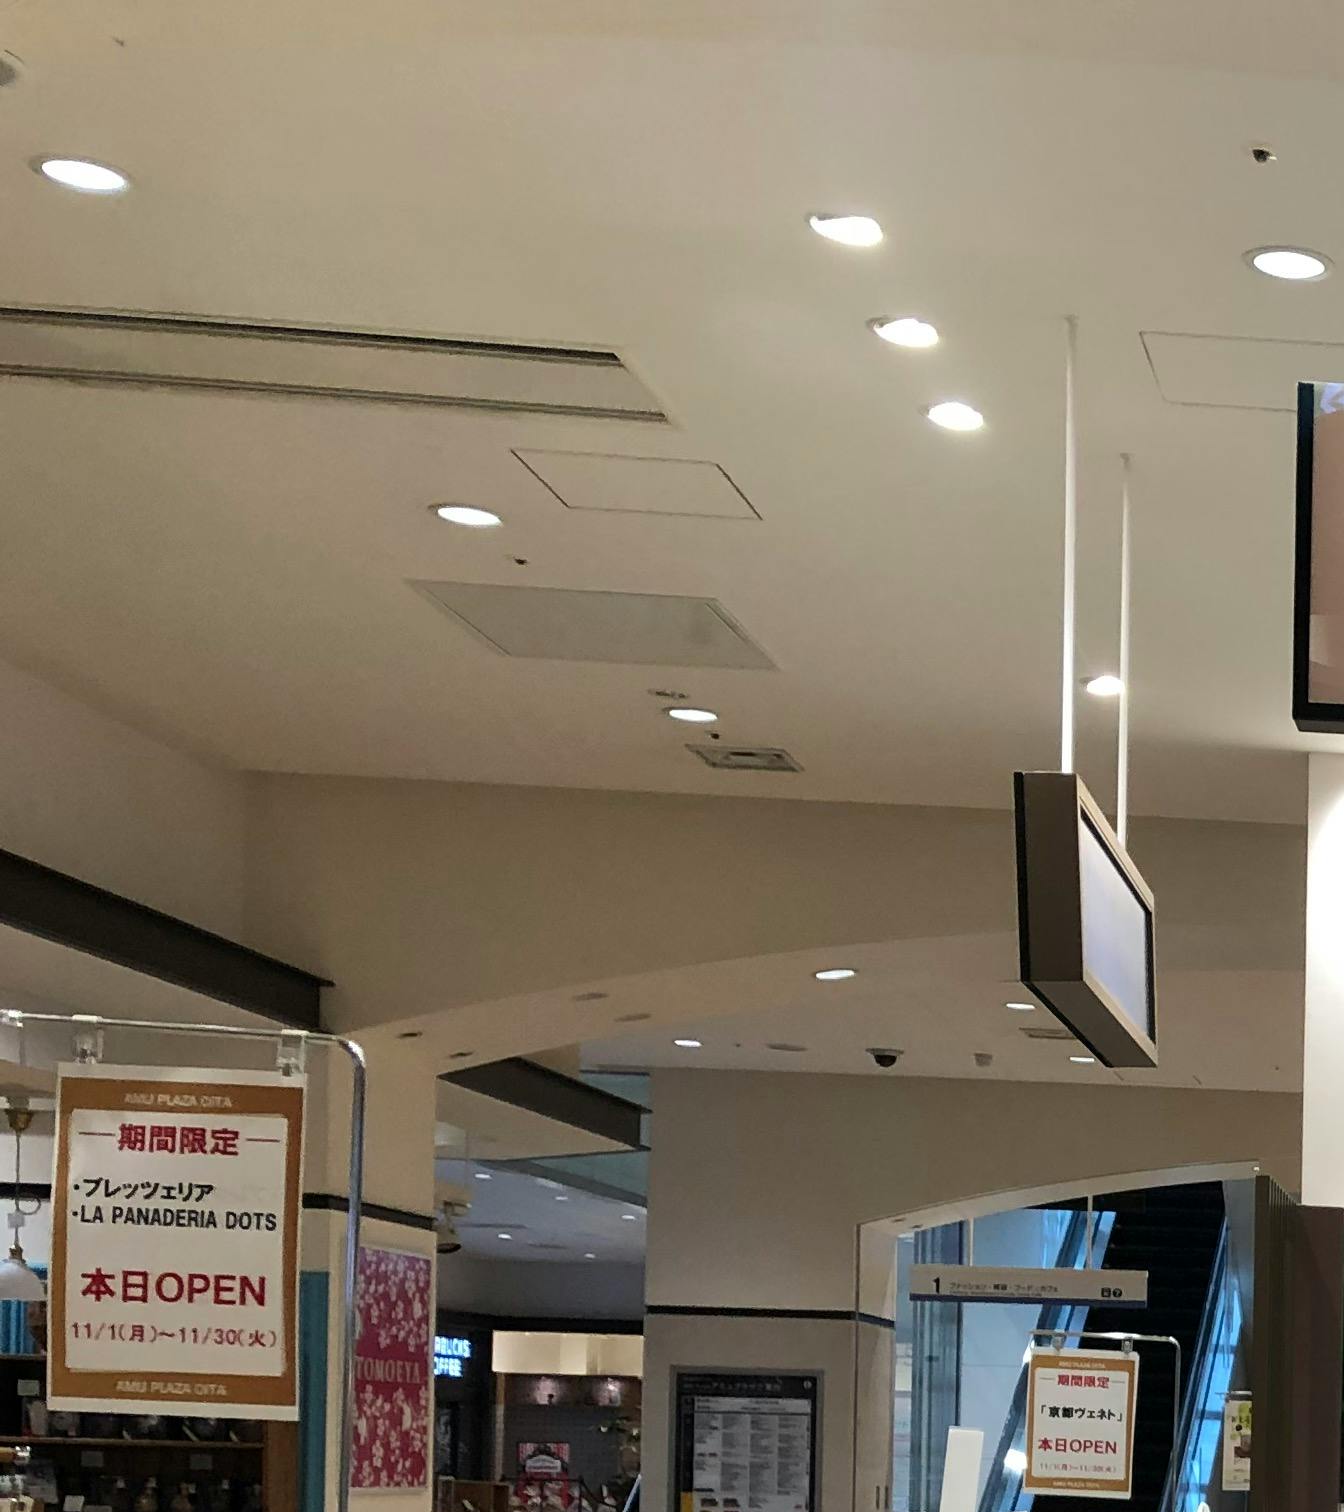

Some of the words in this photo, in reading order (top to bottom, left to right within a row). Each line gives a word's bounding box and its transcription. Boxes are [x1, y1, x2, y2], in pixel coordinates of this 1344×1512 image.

[118, 1122, 240, 1156] 期間限定
[112, 1207, 217, 1229] PANADERIA
[225, 1211, 277, 1231] DOTS
[81, 1268, 266, 1306] 本日OPEN
[150, 1381, 192, 1395] PLAZA
[1057, 1374, 1110, 1389] 期間限定
[1040, 1405, 1123, 1422] 「京都ヴェネト」
[1038, 1437, 1117, 1454] 本日OPEN
